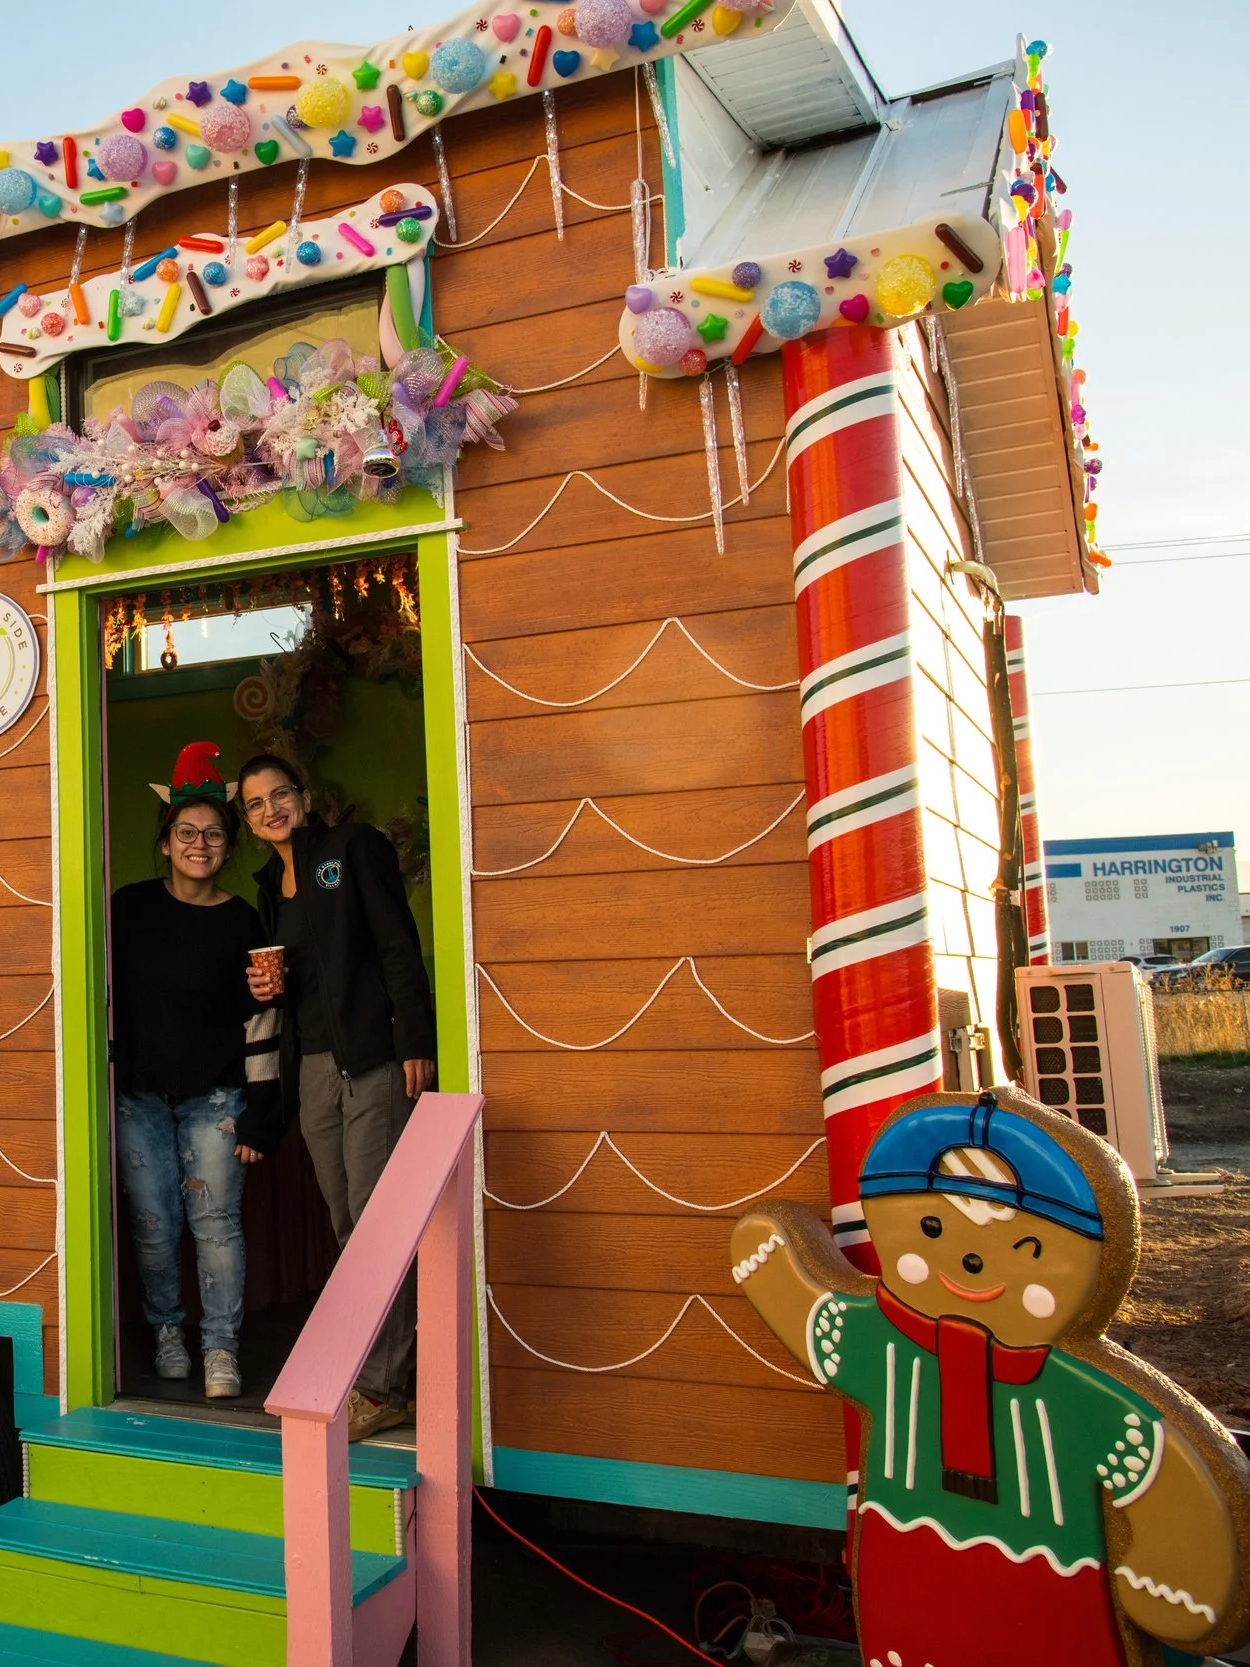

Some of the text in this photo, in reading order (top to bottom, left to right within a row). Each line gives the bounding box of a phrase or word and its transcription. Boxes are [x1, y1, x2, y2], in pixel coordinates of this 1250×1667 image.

[2, 612, 28, 650] SIDE
[1093, 857, 1223, 877] HARRINGTON
[1165, 874, 1224, 884] INDUSTRIAL
[1177, 883, 1226, 893] PLASTICS
[1169, 925, 1191, 933] 1907
